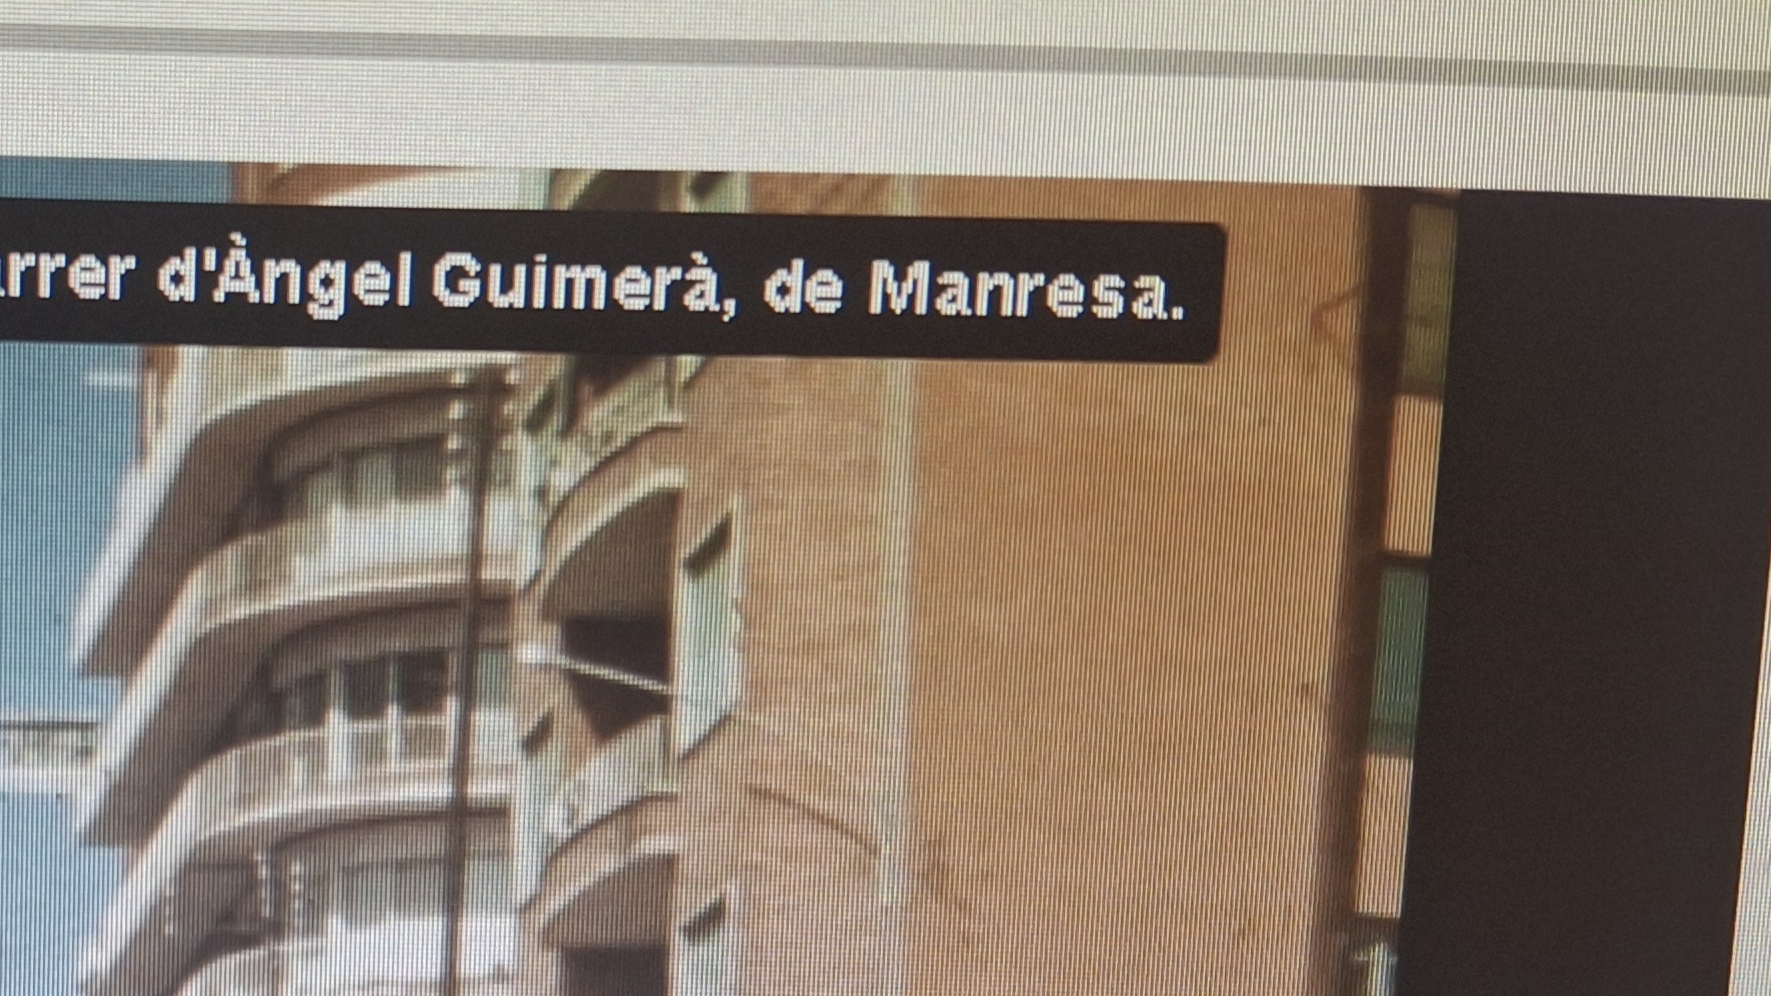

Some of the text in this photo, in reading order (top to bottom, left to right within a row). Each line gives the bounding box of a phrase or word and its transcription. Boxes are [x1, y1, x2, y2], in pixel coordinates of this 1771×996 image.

[158, 232, 411, 320] d'Àngel
[433, 252, 736, 321] Guimerà,
[764, 258, 843, 313] de
[870, 260, 1183, 319] Manresa.
